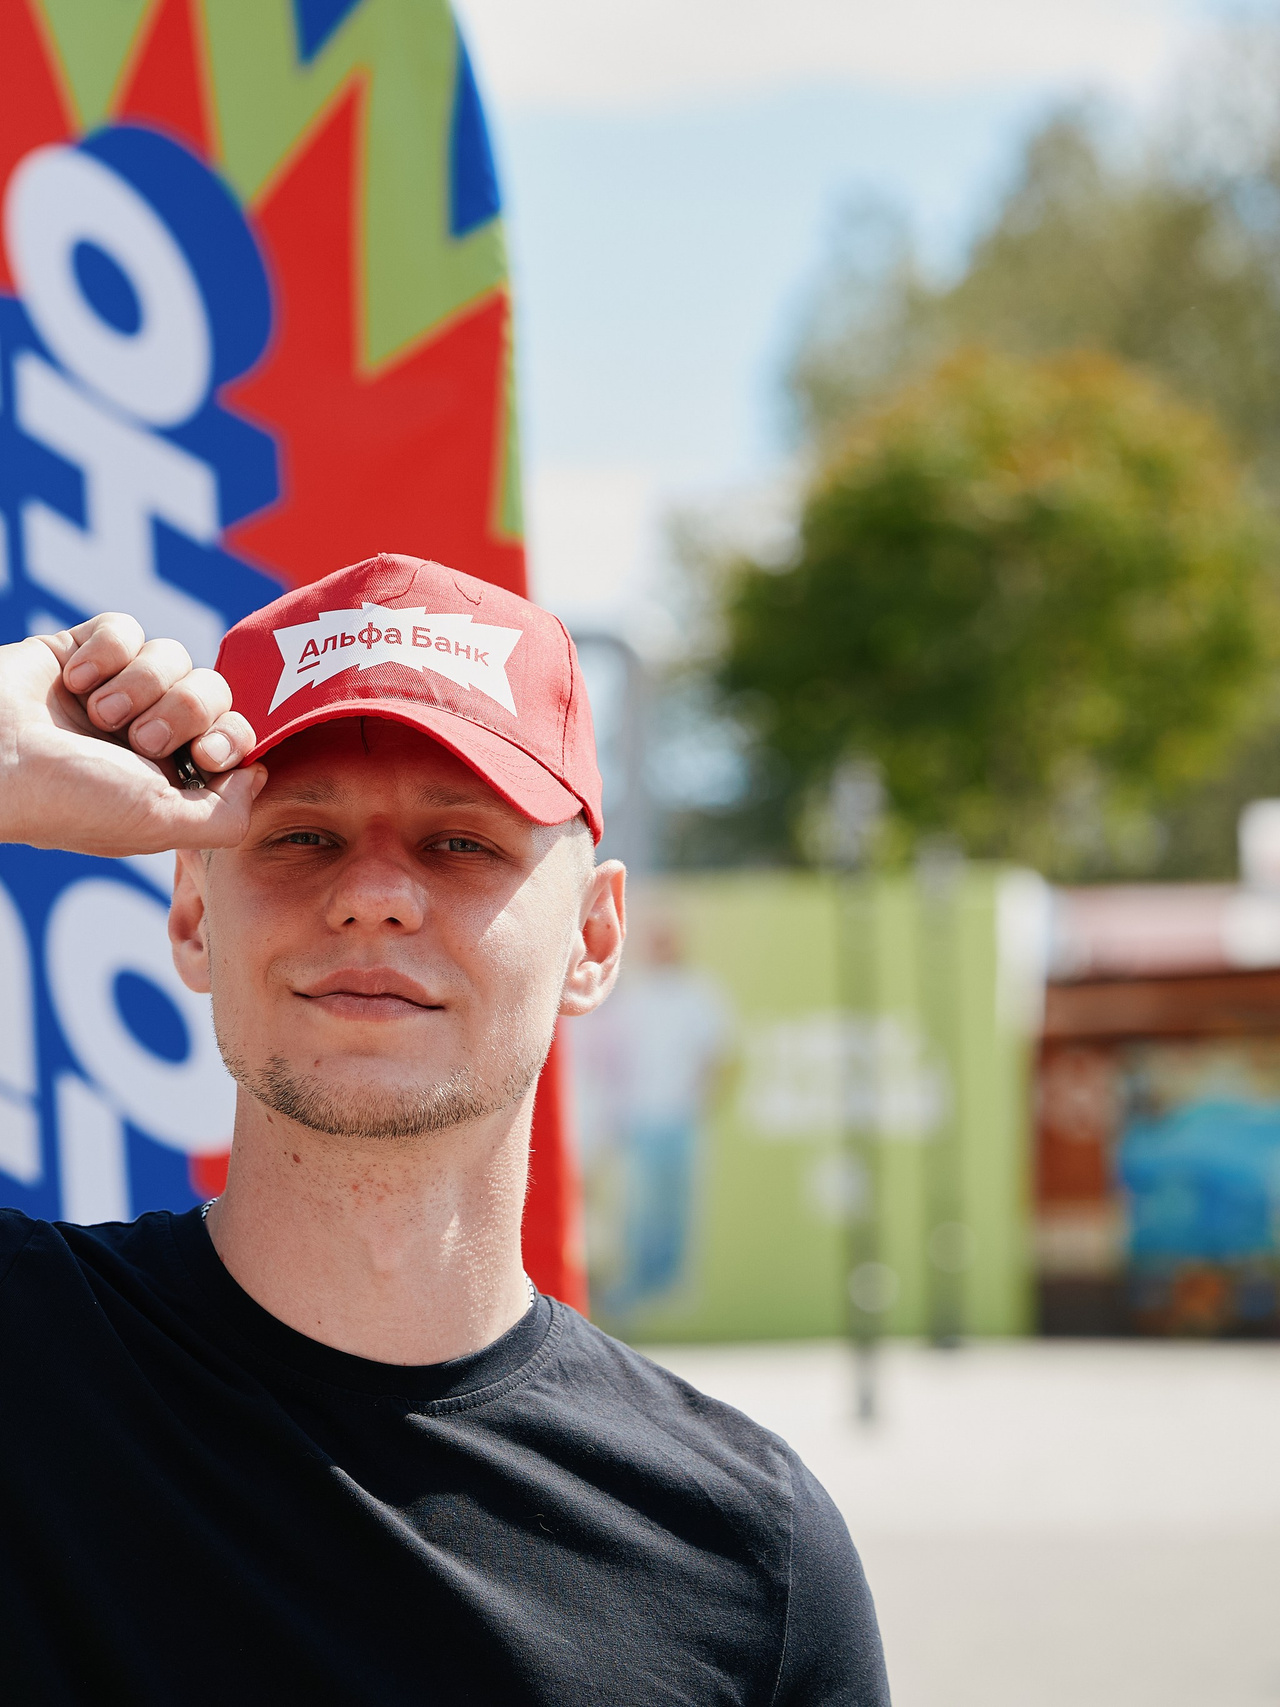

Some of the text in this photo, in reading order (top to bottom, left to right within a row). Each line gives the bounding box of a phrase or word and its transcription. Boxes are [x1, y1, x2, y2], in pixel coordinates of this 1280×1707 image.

[4, 143, 237, 1225] ОНО
[297, 622, 490, 674] Альфа Банк
